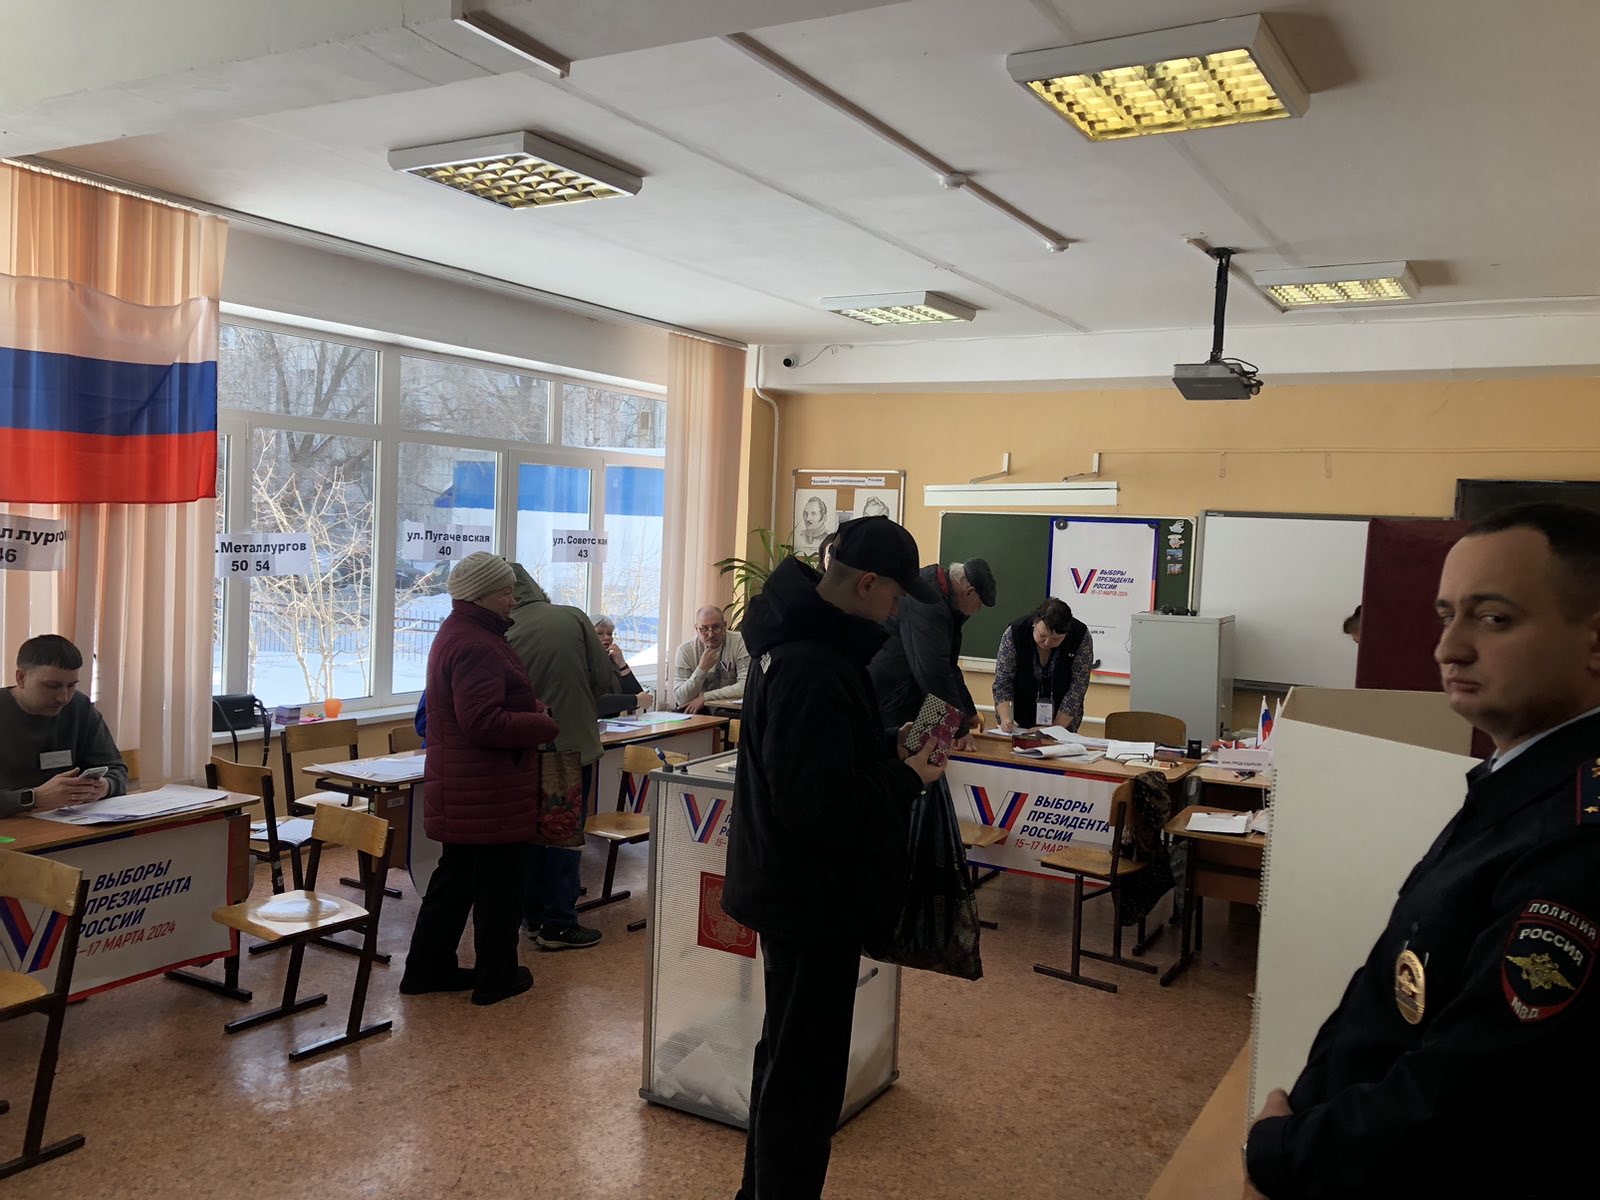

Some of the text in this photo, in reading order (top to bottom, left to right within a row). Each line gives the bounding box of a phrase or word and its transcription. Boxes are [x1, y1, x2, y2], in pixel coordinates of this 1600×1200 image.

[438, 545, 452, 556] 40
[577, 549, 589, 558] 43
[231, 560, 270, 572] 50 54
[1095, 576, 1135, 584] ПРЕЗИДЕНТА
[1034, 795, 1095, 815] ВЫБОРЫ
[1019, 824, 1074, 843] РОССИИ
[1026, 810, 1110, 834] ПРЕЗИДЕНТА
[92, 859, 172, 892] ВЫБОРЫ
[83, 875, 192, 917] ПРЕЗИДЕНТА
[1528, 903, 1597, 941] ПОЛИЦИЯ
[102, 928, 144, 953] МАРТА
[146, 920, 177, 941] 2024
[1519, 928, 1584, 967] РОССИЯ
[1511, 996, 1539, 1019] МВД
